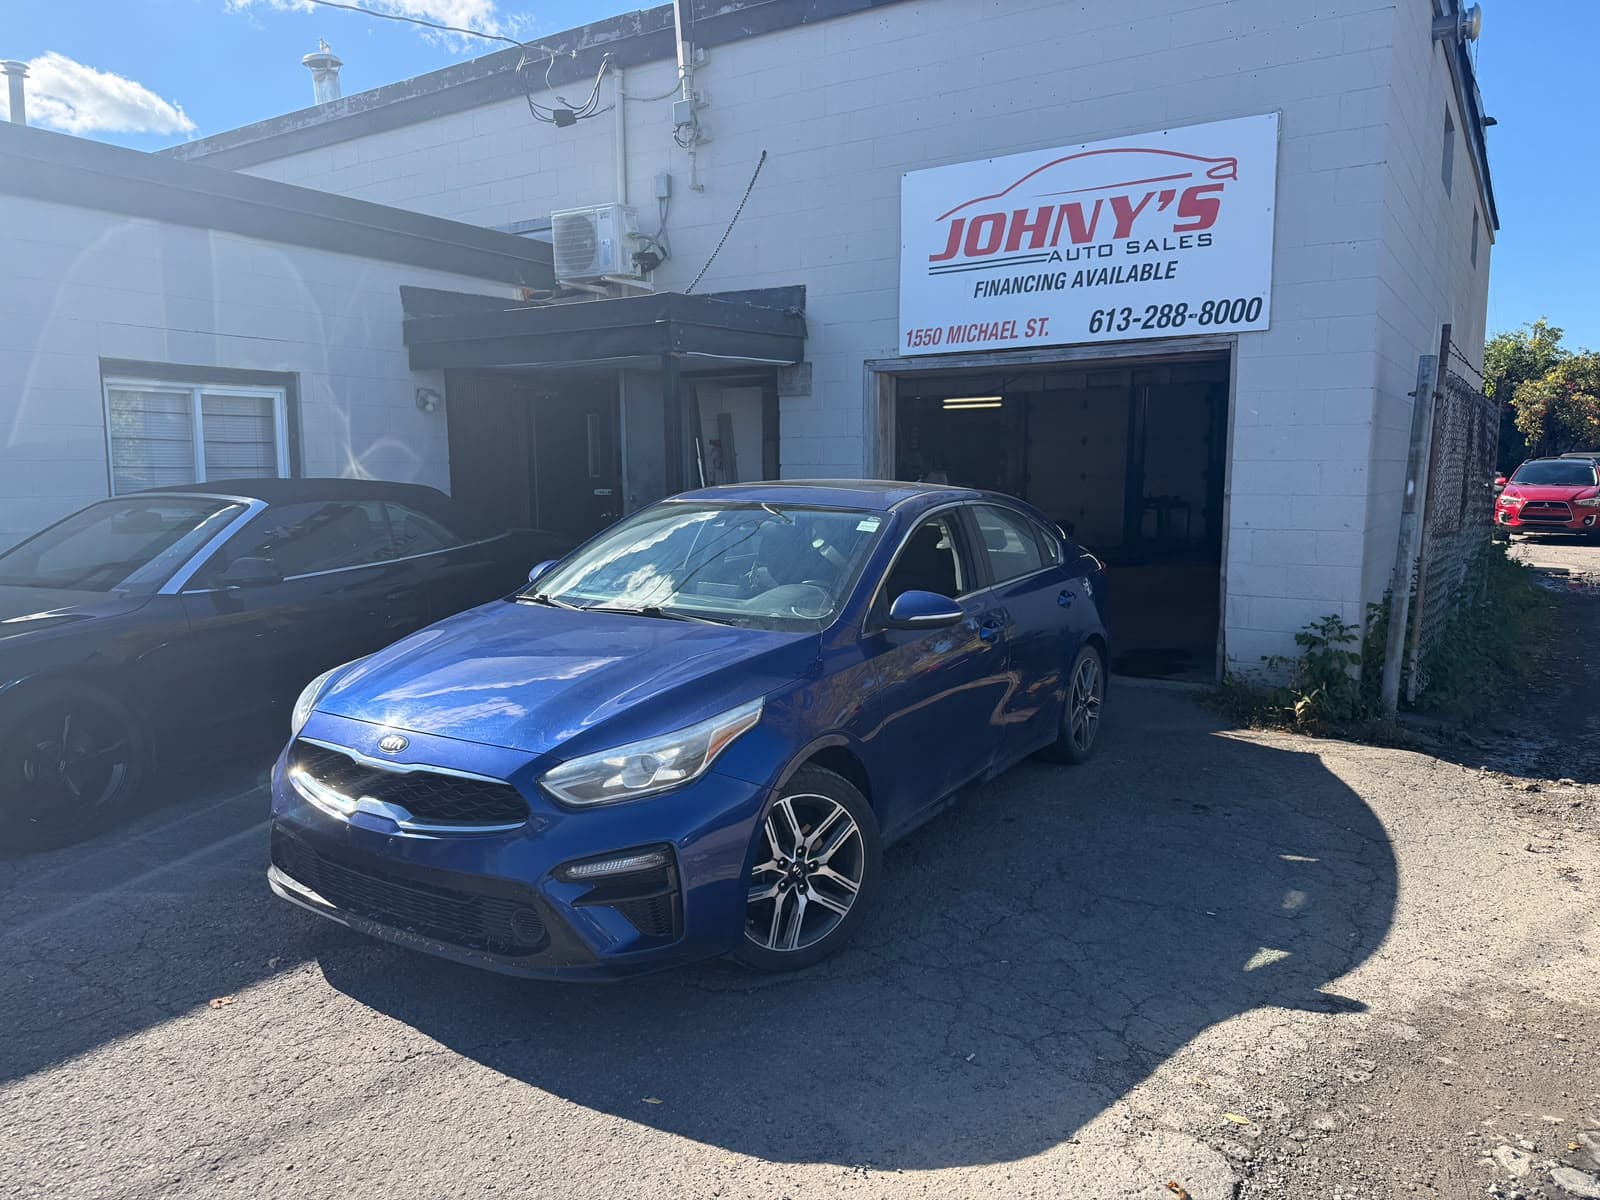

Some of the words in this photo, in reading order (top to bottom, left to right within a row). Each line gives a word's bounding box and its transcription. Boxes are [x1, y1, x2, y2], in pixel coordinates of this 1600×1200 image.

[929, 183, 1225, 262] JOHNY'S
[1048, 244, 1113, 263] AUTO
[1126, 233, 1212, 254] SALES
[974, 272, 1067, 298] FINANCING
[1071, 261, 1178, 288] AVAILABLE
[906, 327, 942, 347] 1550
[946, 320, 1018, 344] MICHAEL
[1025, 317, 1049, 337] ST.
[1089, 297, 1263, 334] 613-288-8000
